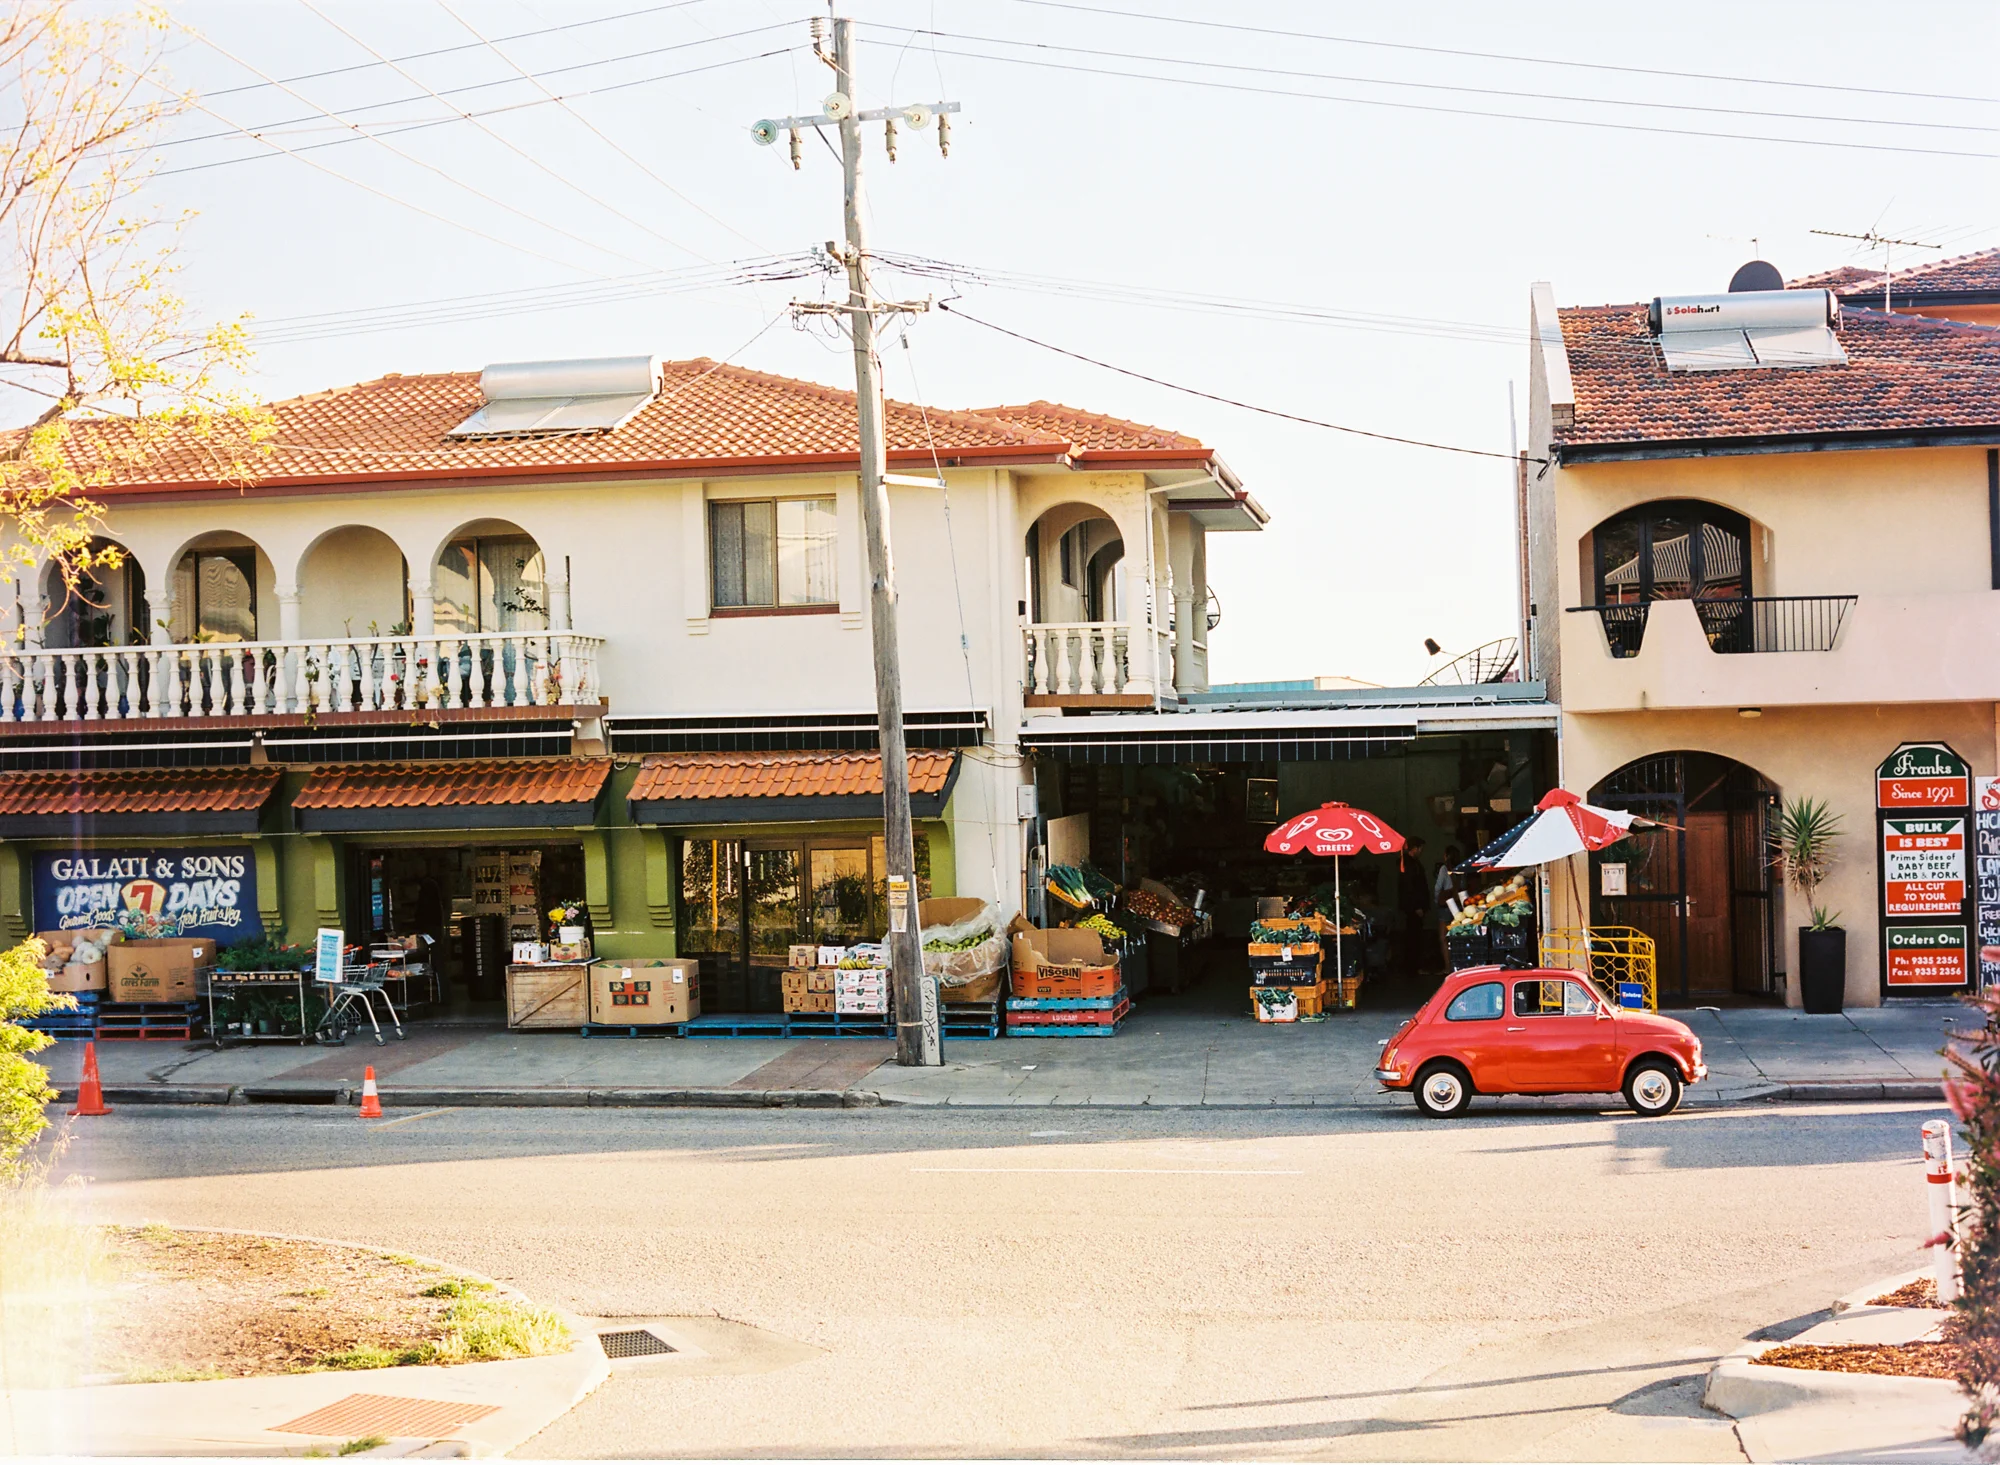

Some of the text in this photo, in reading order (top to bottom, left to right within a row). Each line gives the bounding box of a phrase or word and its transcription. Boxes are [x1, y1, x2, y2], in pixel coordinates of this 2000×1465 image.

[1893, 751, 1952, 776] Franks
[1891, 782, 1955, 803] Since 1991
[1976, 812, 2000, 831] HIC
[1905, 822, 1943, 833] BULK
[1899, 836, 1949, 848] IS BEST
[1316, 844, 1352, 852] STREETS
[1890, 852, 1956, 861] Prime Sides of
[51, 856, 245, 880] GALATI & SONS
[1898, 862, 1951, 871] BABY BEEF
[1890, 872, 1918, 880] LAMB
[1931, 871, 1959, 879] PORK
[1905, 882, 1945, 891] ALL CUT
[56, 877, 241, 915] OPEN 7 DAYS
[1904, 892, 1947, 901] TO YOUR
[1889, 902, 1962, 912] REQUIREMENTS
[1892, 933, 1960, 945] Orders On:
[1895, 955, 1959, 965] Ph: 9335 2356
[1892, 967, 1962, 976] Fax: 9335 2356
